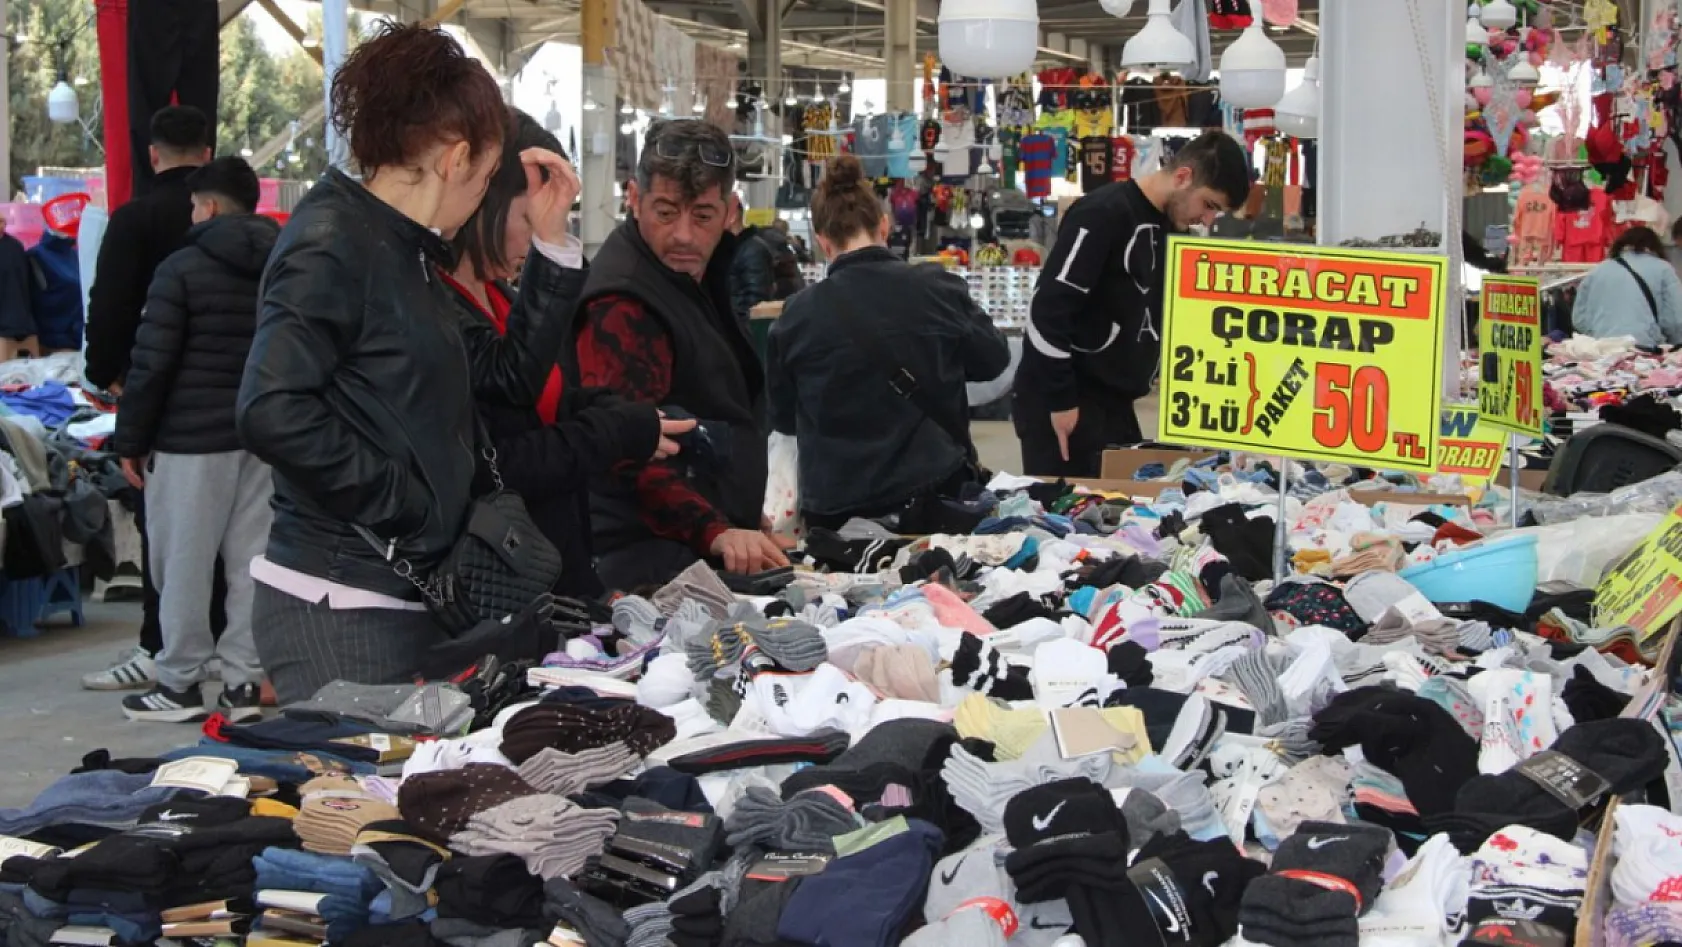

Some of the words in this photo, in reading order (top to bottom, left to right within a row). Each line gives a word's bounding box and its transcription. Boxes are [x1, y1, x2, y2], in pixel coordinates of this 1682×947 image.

[1195, 253, 1418, 309] İHRACAT
[1211, 306, 1395, 353] ÇORAP
[1173, 346, 1238, 386] 2'Lİ
[1171, 392, 1239, 433] 3'LÜ
[1254, 357, 1310, 438] PAKET
[1312, 362, 1390, 453] 50
[1393, 431, 1427, 459] TL
